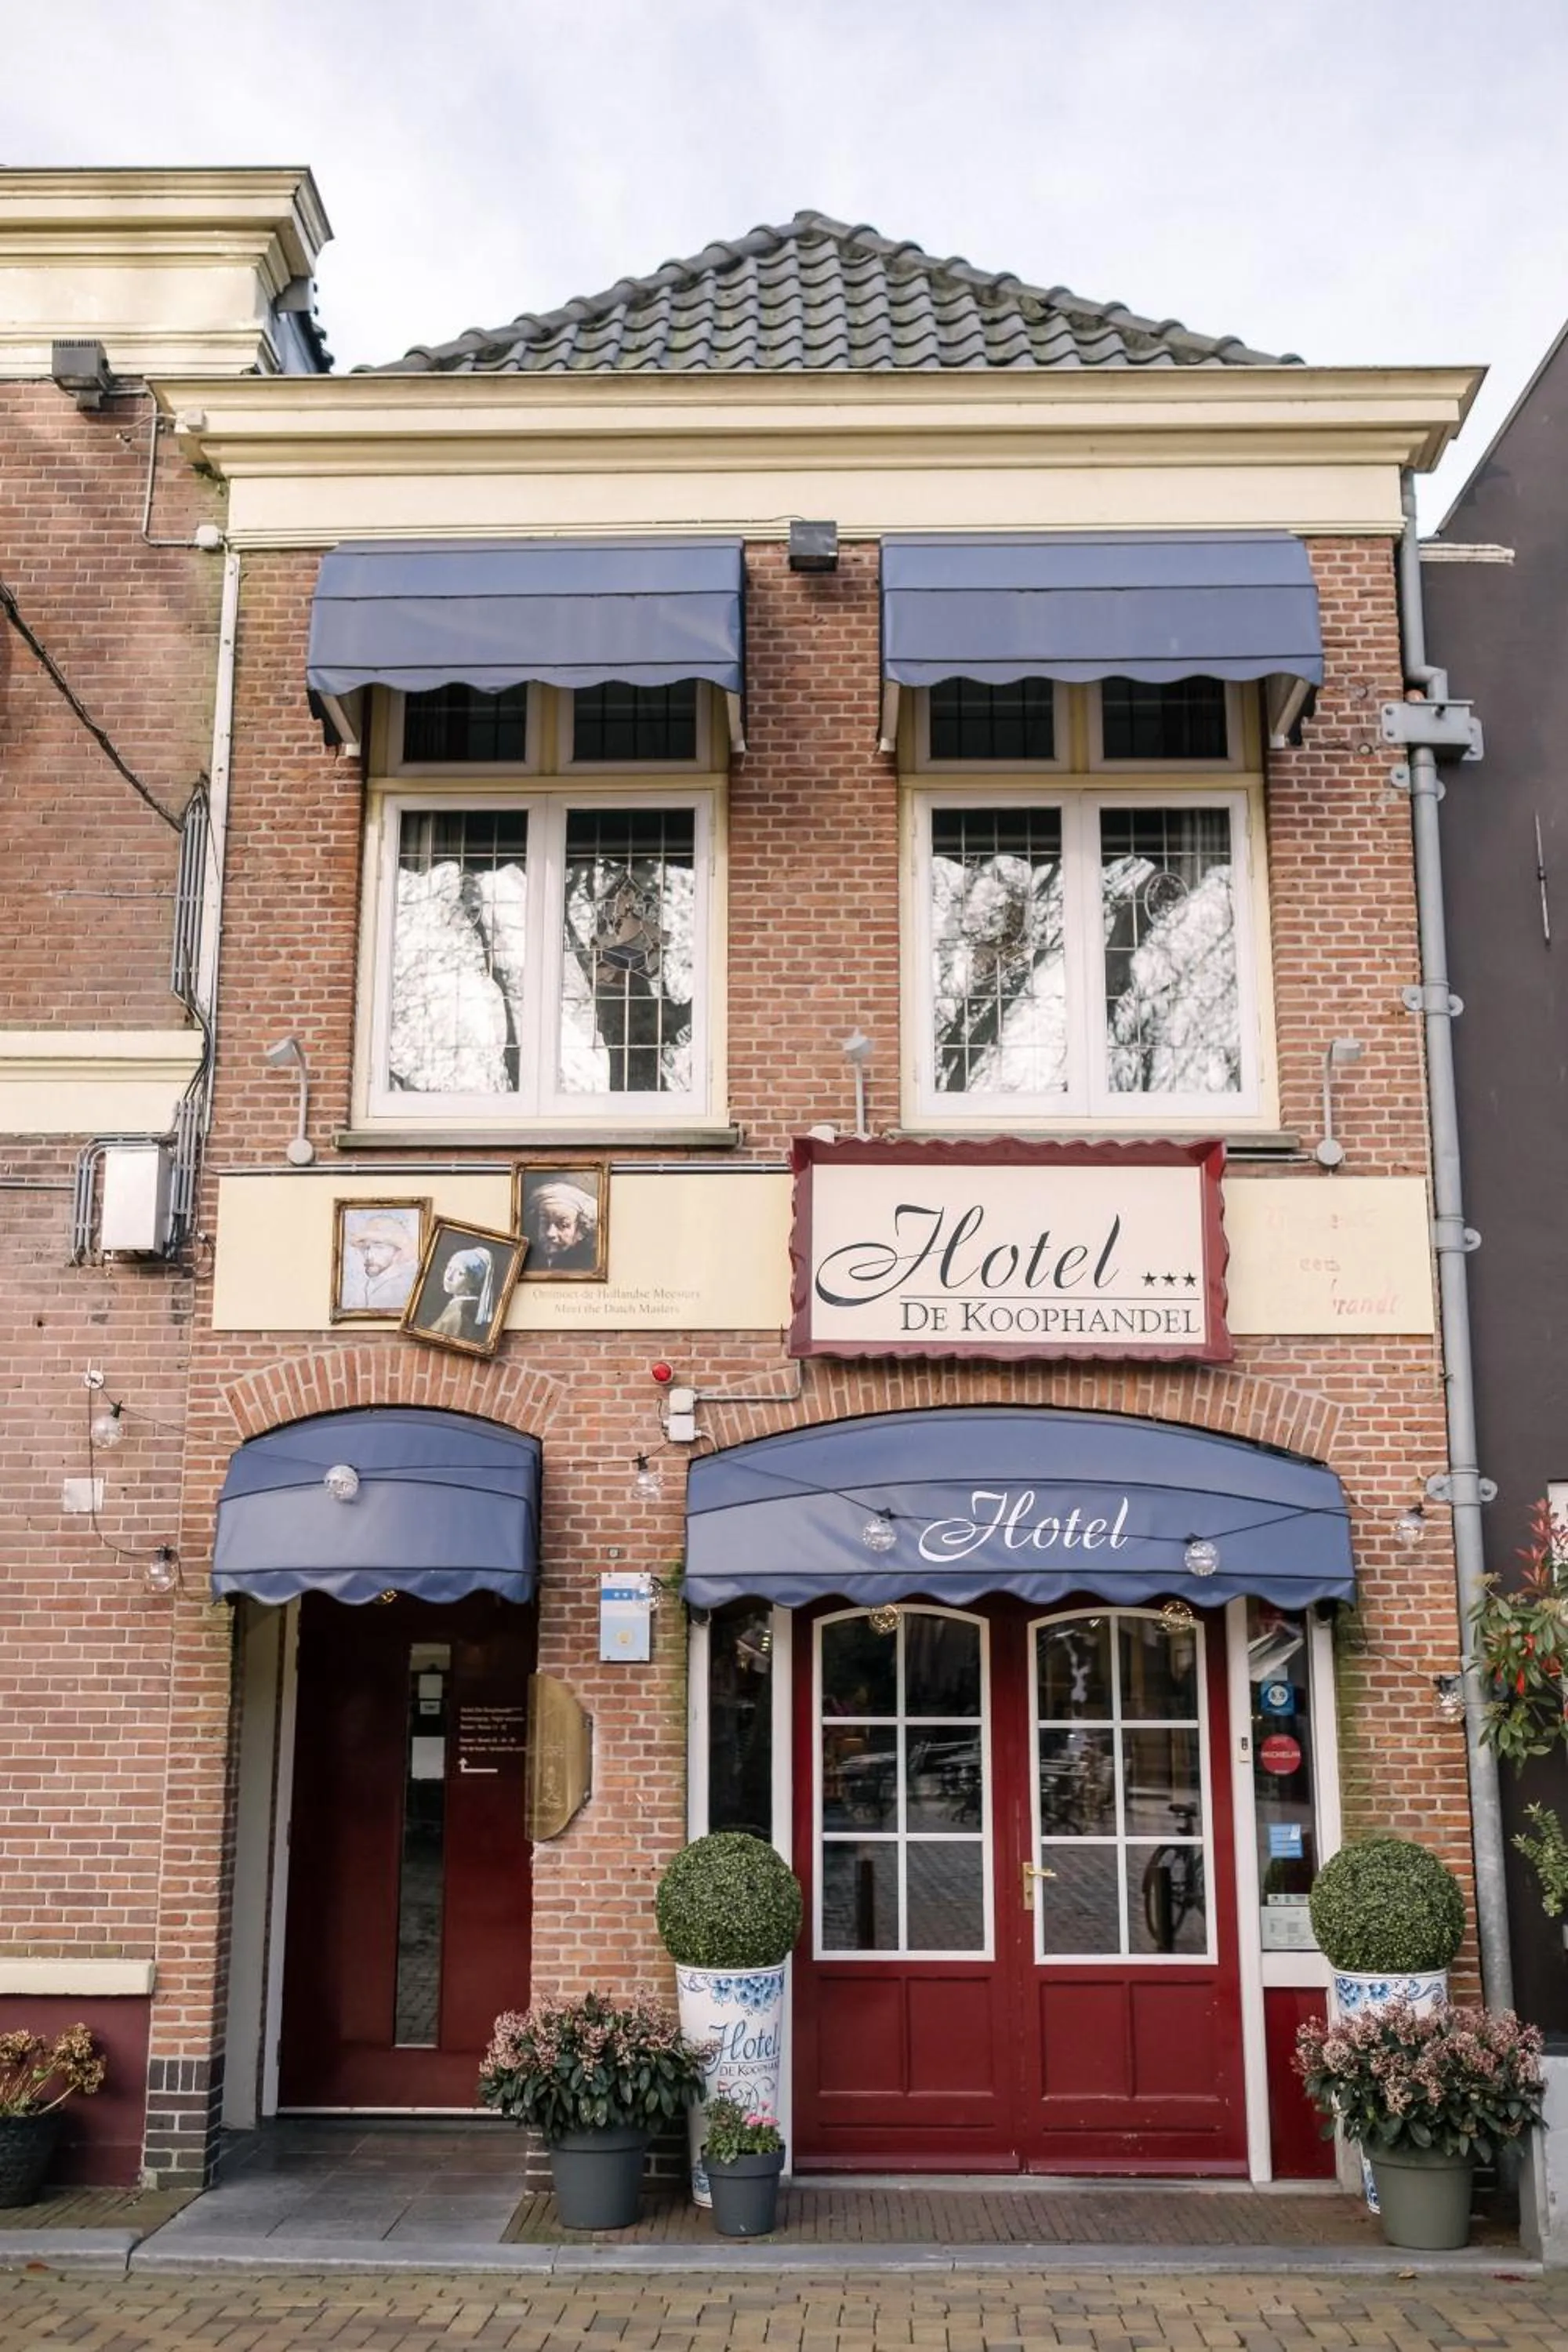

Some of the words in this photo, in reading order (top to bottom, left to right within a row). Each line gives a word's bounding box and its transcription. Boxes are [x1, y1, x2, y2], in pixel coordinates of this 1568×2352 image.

[815, 1203, 1120, 1307] Hotel
[604, 1303, 635, 1314] Dutch
[918, 1490, 1128, 1562] Hotel
[704, 2019, 779, 2077] Hotel
